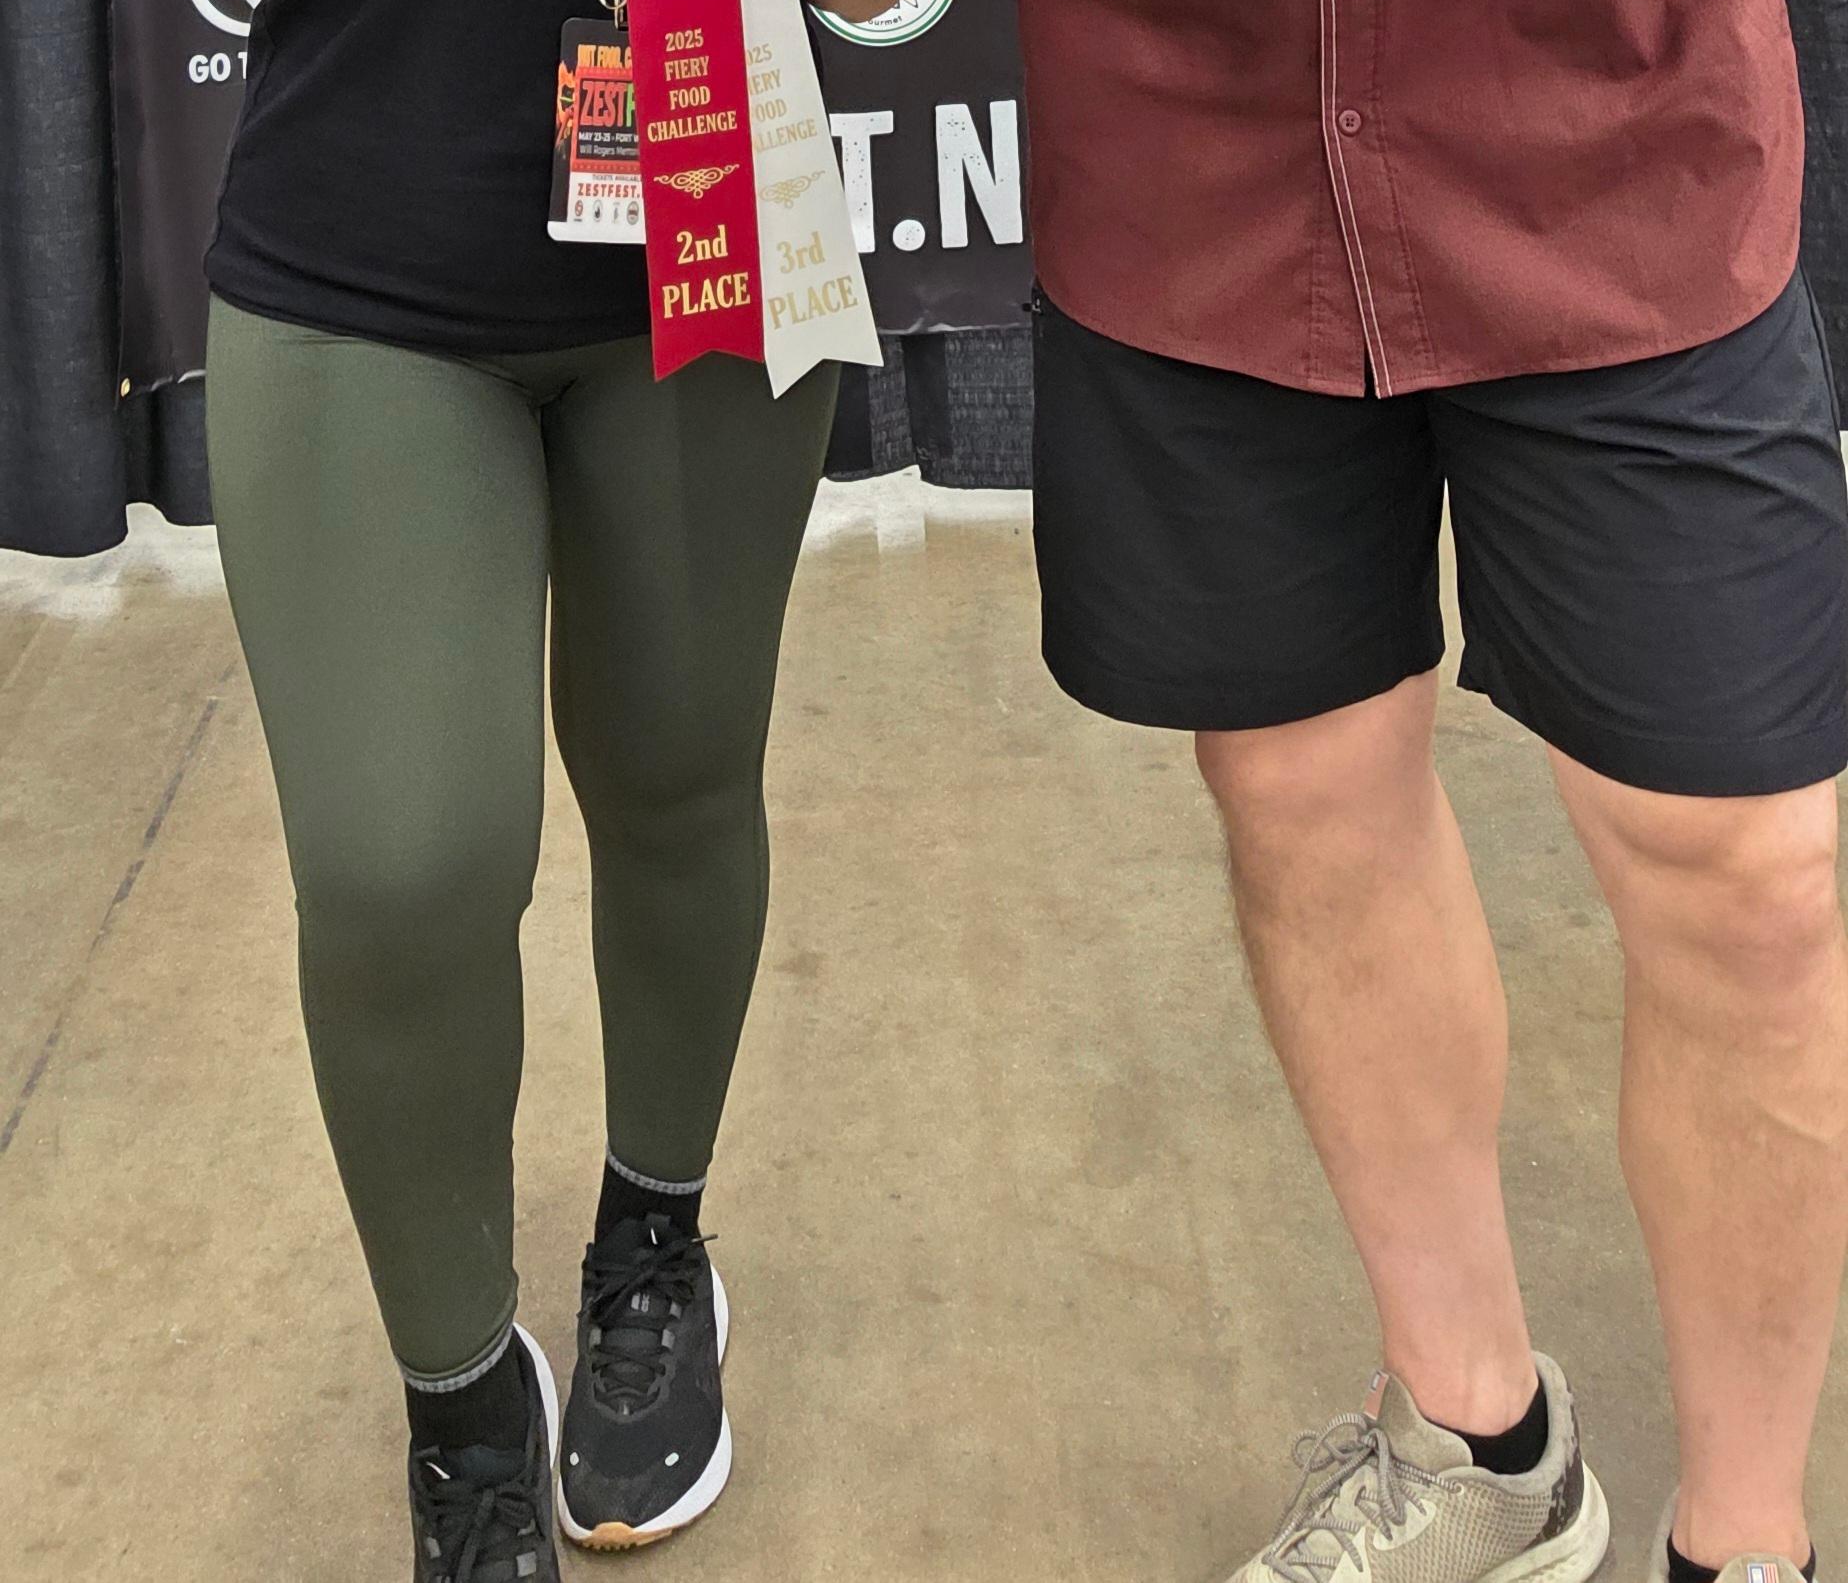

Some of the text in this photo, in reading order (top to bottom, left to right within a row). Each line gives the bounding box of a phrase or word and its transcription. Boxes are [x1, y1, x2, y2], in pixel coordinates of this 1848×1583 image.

[664, 28, 704, 52] 2025
[189, 53, 231, 83] GO
[664, 55, 710, 82] FIERY
[668, 86, 711, 110] FOOD
[754, 99, 788, 123] OOD
[647, 110, 738, 143] CHALLENGE
[676, 224, 729, 265] 2nd
[776, 230, 826, 275] 3rd
[661, 272, 751, 319] PLACE
[768, 275, 858, 330] PLACE
